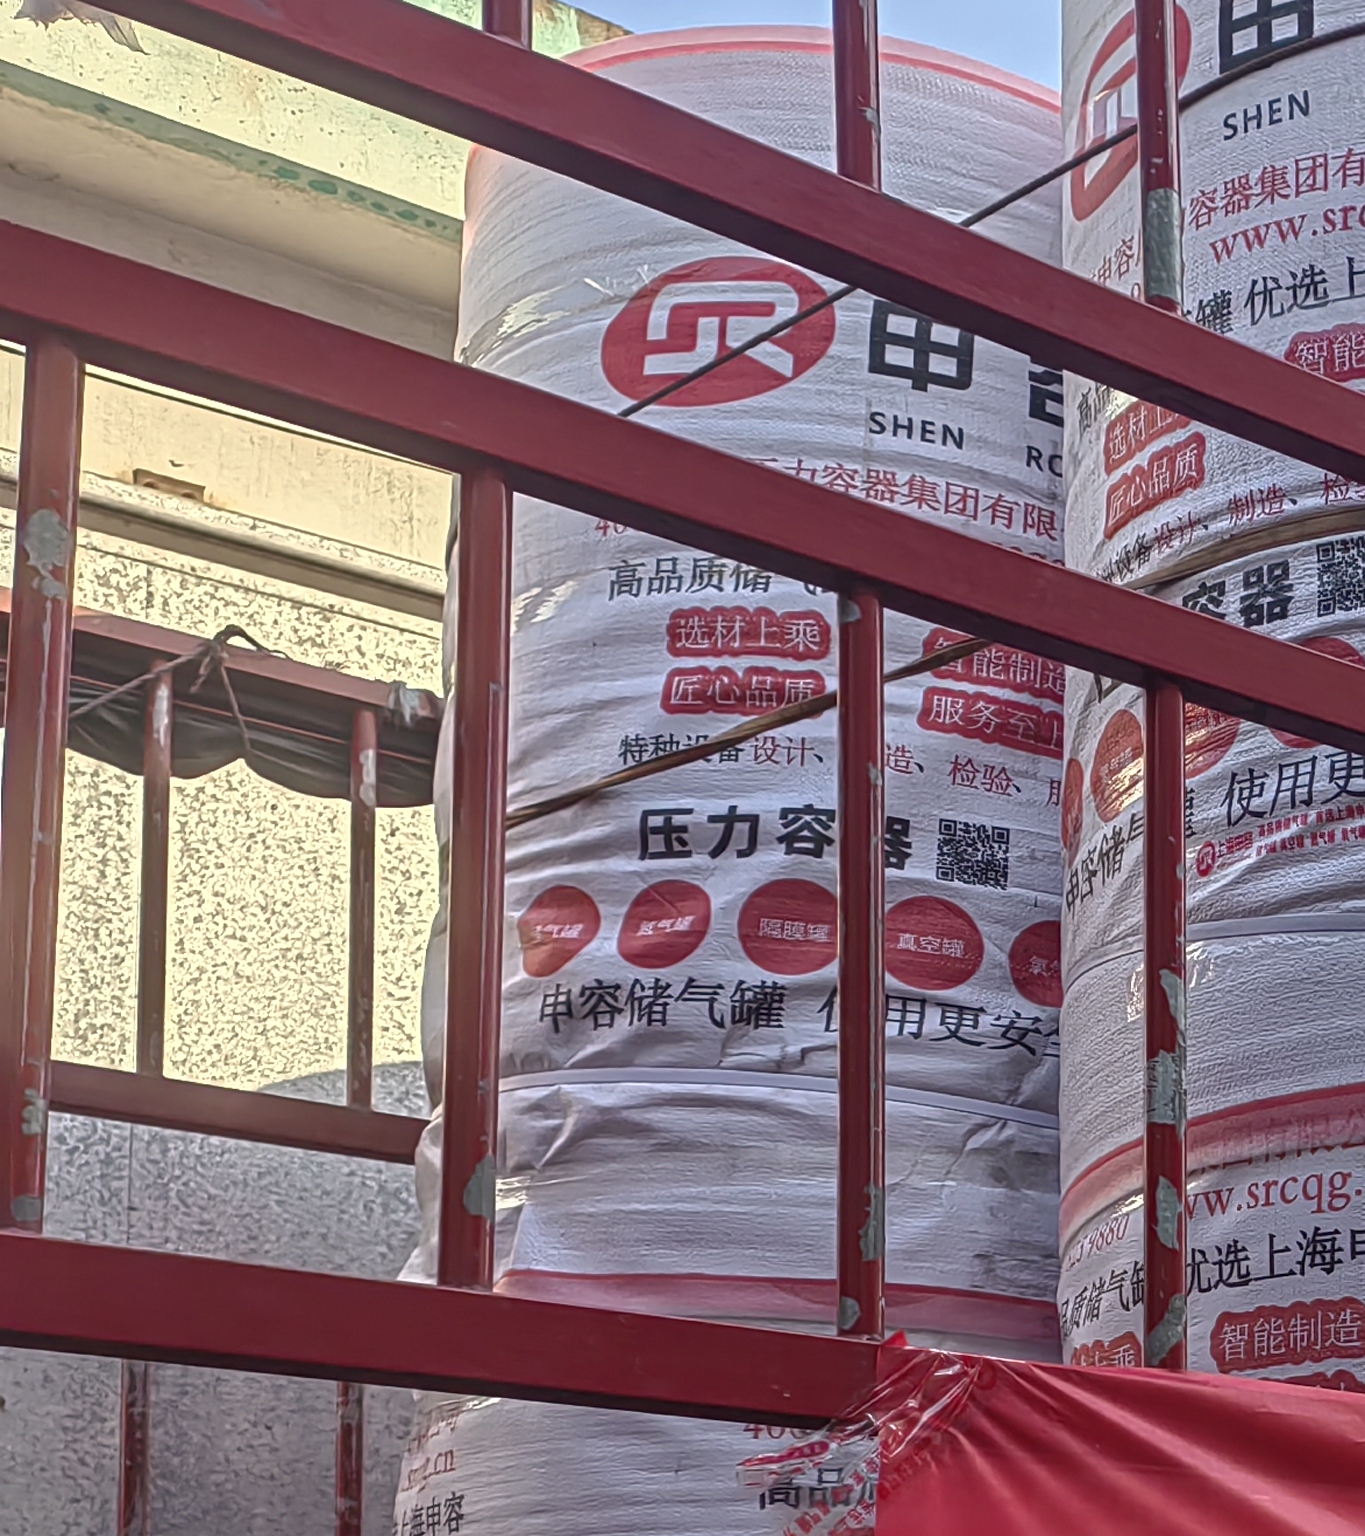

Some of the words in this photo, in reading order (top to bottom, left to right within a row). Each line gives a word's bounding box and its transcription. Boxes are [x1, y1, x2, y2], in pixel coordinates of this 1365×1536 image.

[1222, 90, 1311, 141] SHEN
[868, 411, 965, 450] SHEN
[1108, 405, 1188, 465] 选材上
[1107, 443, 1201, 528] 匠心品质
[675, 616, 822, 653] 选材上乘
[670, 676, 815, 708] 匠心品质
[540, 977, 788, 1033] 申容储气罐
[1218, 1308, 1364, 1361] 智能制造
